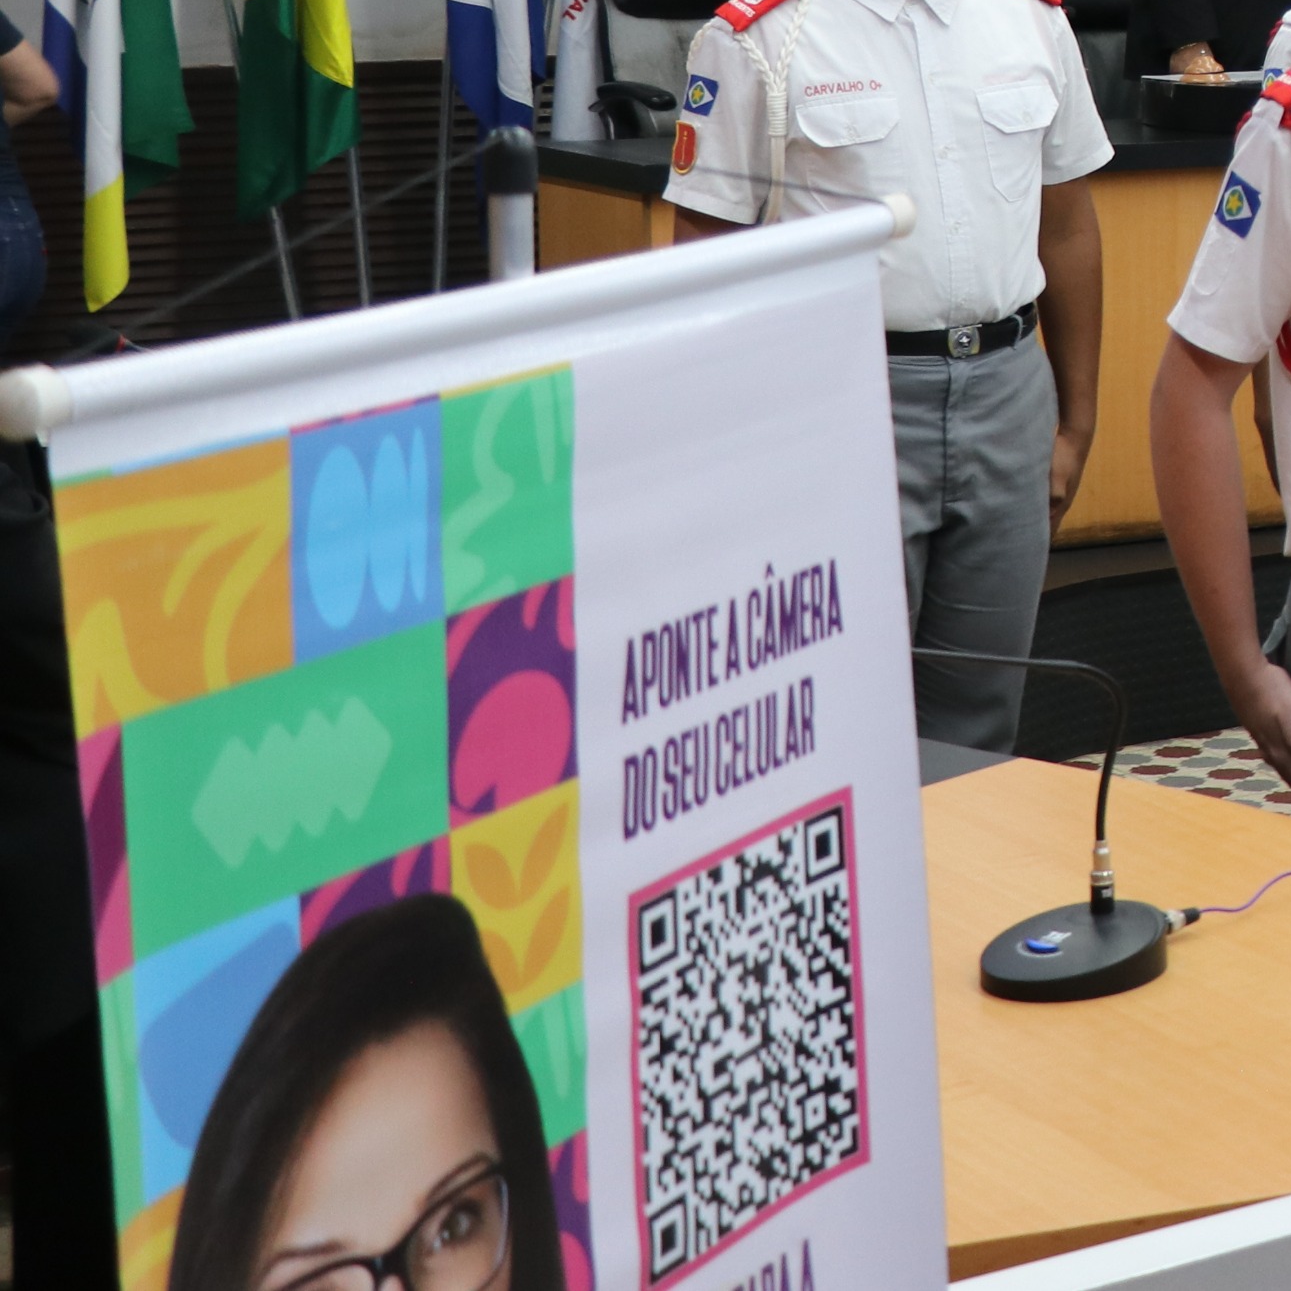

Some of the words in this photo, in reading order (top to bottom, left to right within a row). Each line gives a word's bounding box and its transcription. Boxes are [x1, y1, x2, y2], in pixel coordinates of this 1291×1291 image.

[804, 80, 864, 97] CARVALHO
[622, 604, 719, 726] APONTE
[725, 597, 741, 681] A
[747, 558, 843, 672] CÂMERA
[623, 746, 657, 842] DO
[661, 722, 709, 822] SEU
[715, 675, 815, 796] CELULAR
